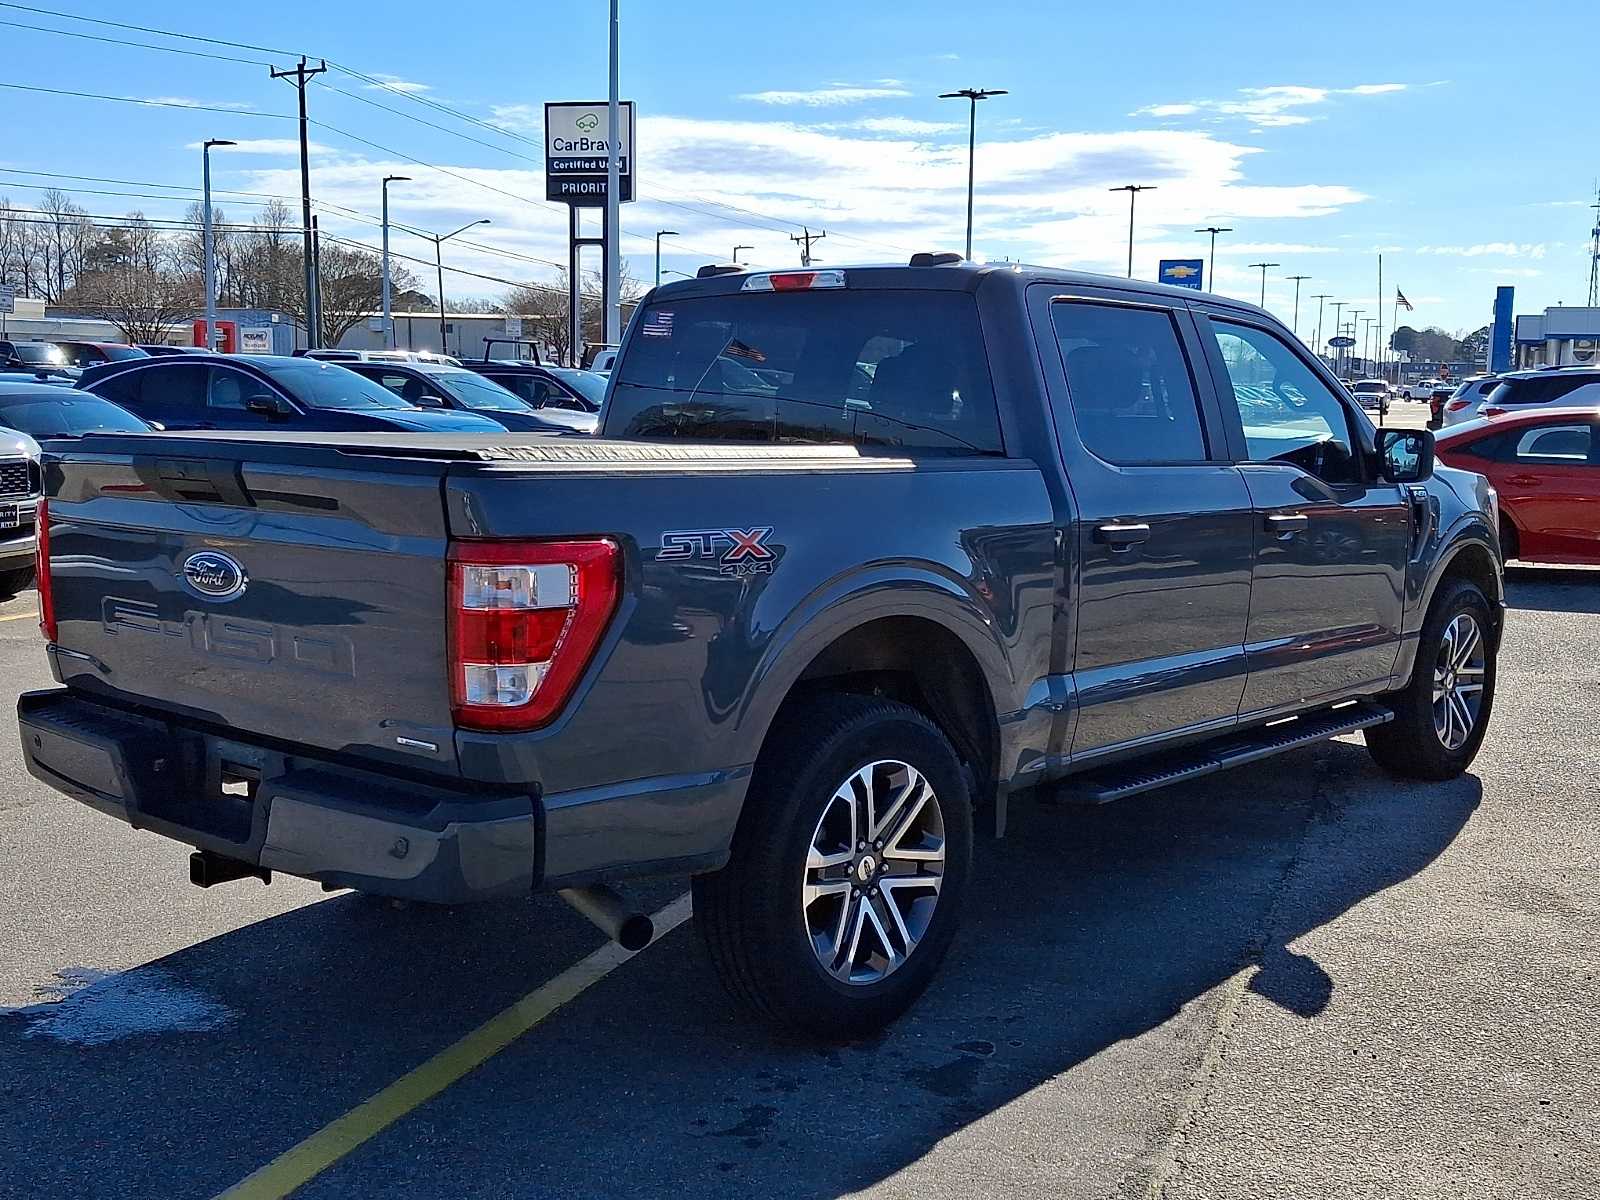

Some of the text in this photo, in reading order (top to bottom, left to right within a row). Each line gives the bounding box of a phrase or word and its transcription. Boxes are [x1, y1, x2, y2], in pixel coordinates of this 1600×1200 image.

[553, 137, 622, 151] CarBrav
[561, 183, 609, 193] PRIORIT
[655, 526, 777, 563] STX
[193, 560, 226, 586] Ford
[100, 595, 357, 680] F-150
